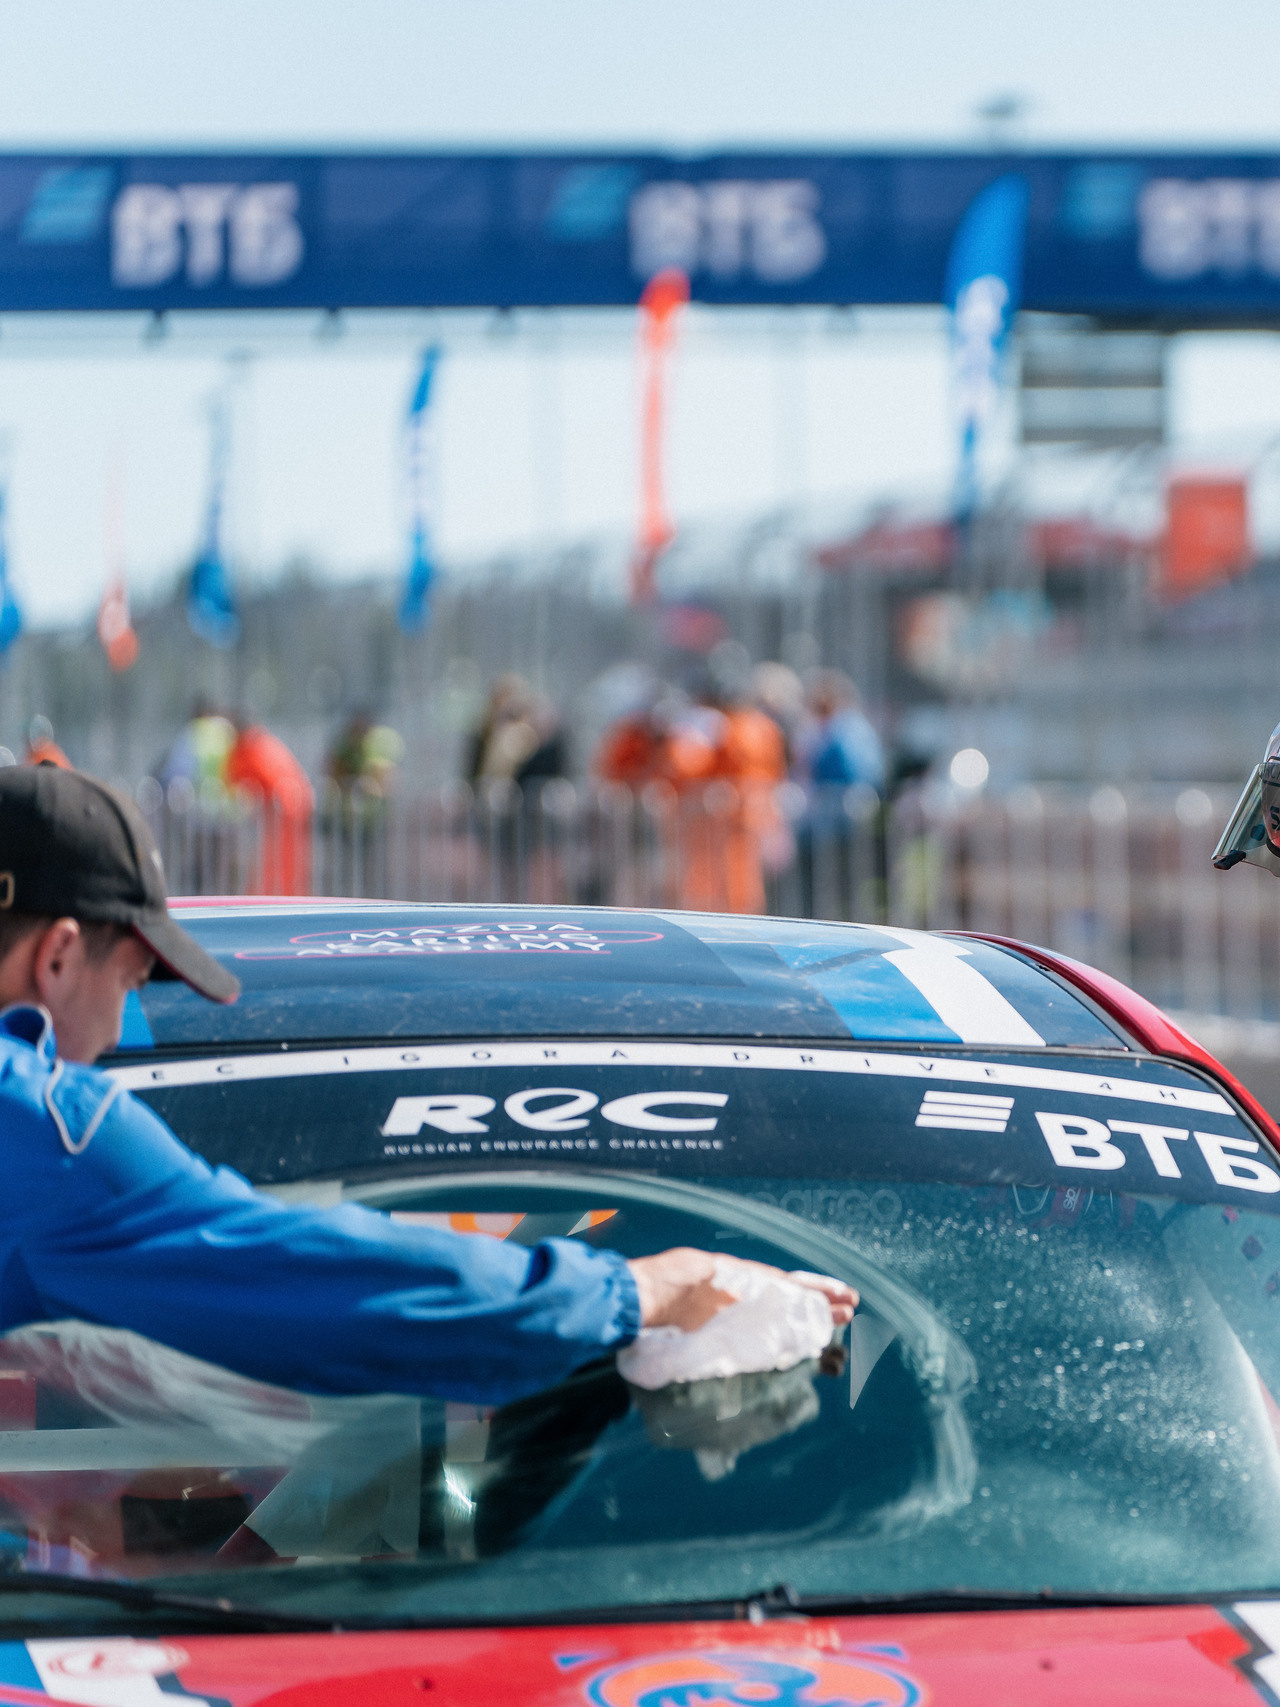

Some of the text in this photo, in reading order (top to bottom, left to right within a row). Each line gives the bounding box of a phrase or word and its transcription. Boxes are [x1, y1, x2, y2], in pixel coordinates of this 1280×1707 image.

[350, 923, 584, 940] MAZDA
[326, 933, 598, 950] KARTING
[342, 1048, 629, 1067] IGORA
[733, 1051, 998, 1076] DRIVE
[384, 1137, 723, 1155] RUSSIAN ENDURANCE CHALLENGE
